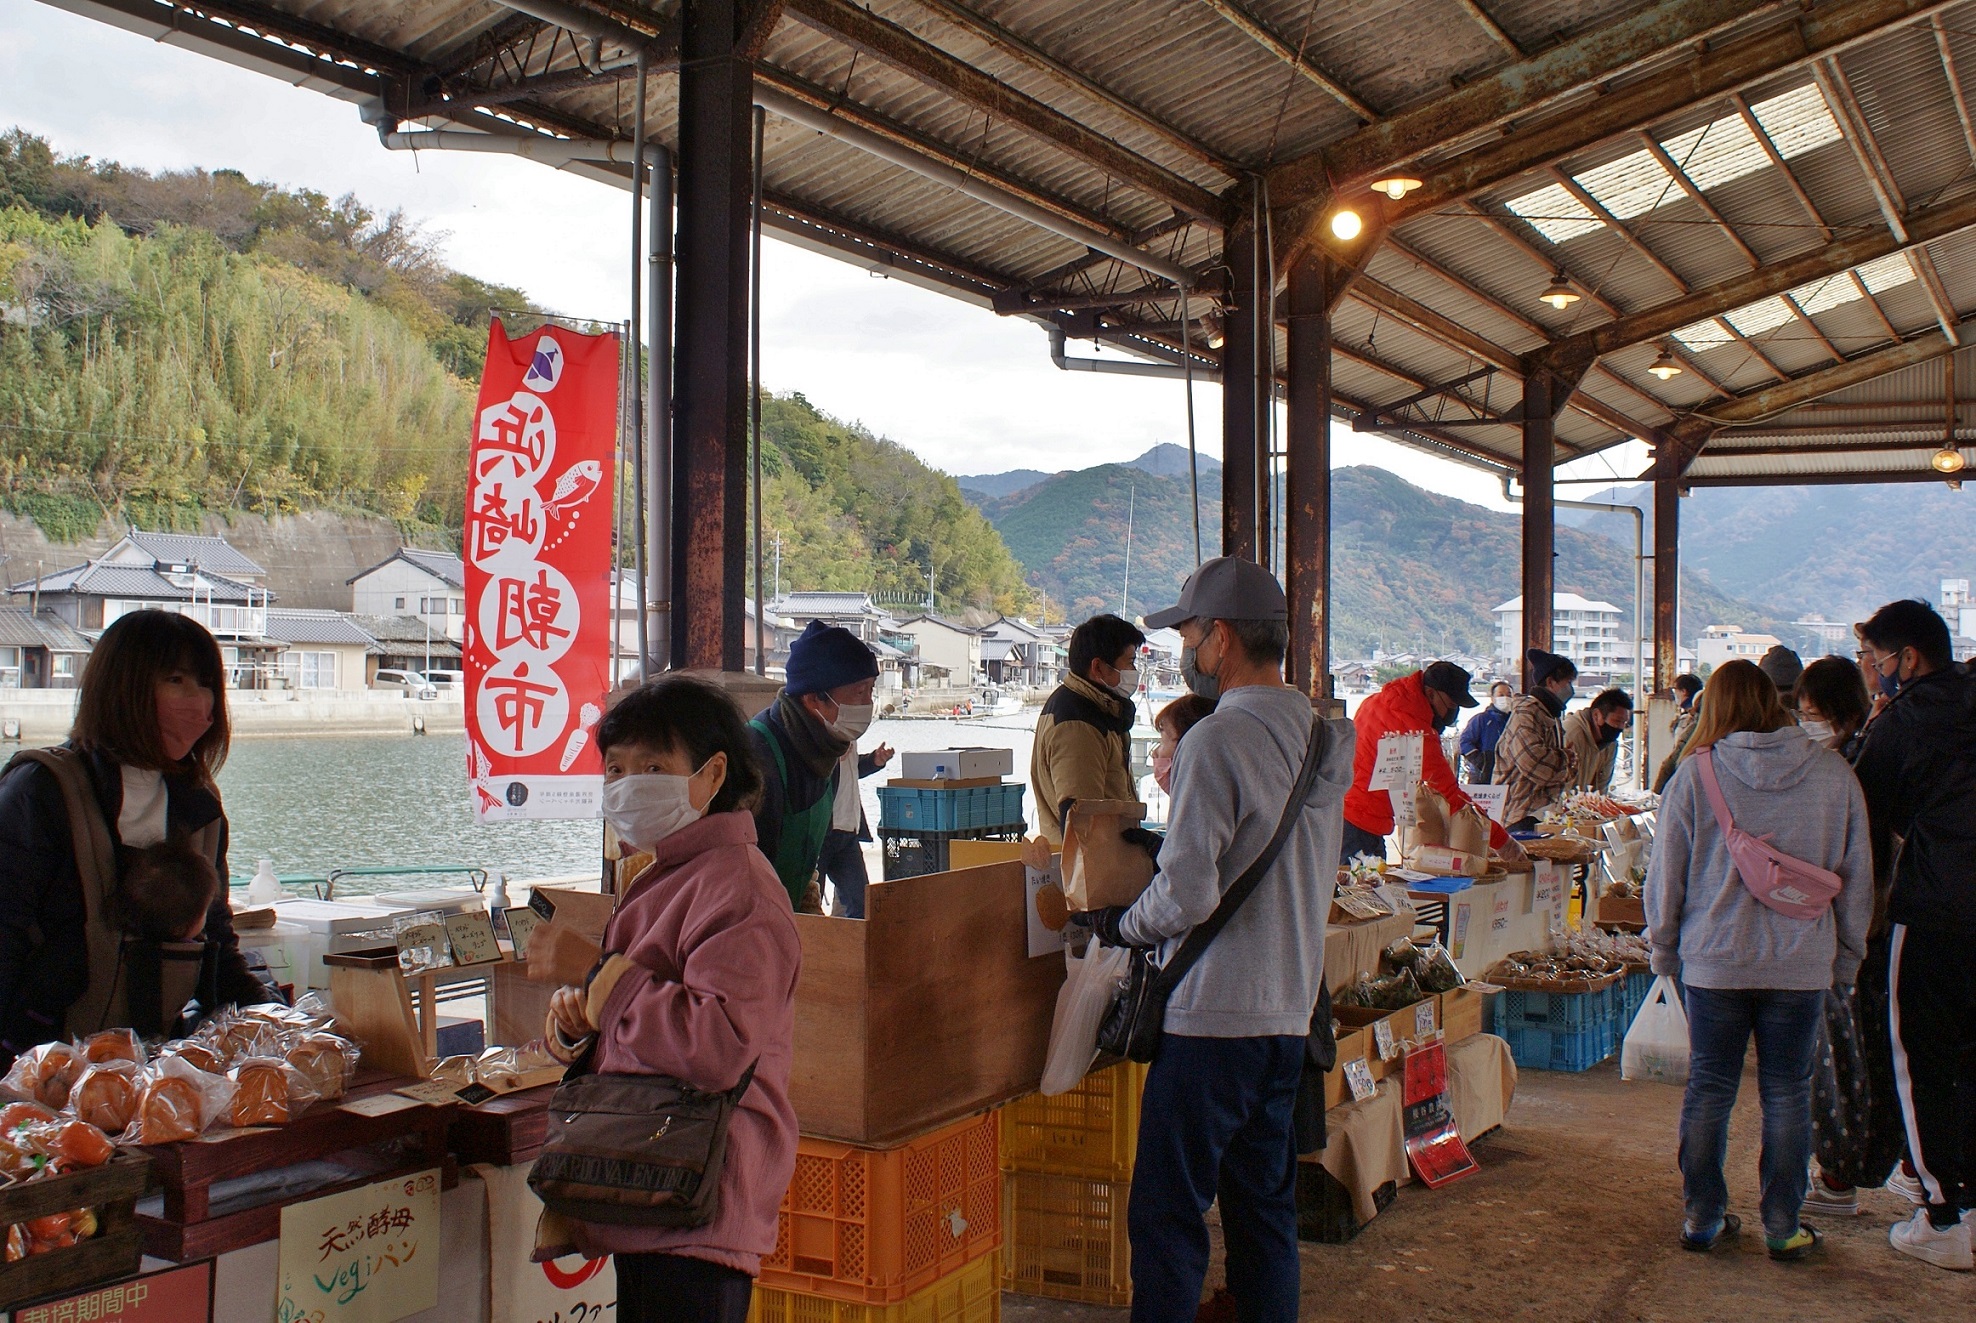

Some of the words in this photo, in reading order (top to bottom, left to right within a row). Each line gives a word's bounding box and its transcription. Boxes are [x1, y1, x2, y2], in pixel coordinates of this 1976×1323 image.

[1779, 885, 1811, 900] NIKE
[604, 1161, 692, 1192] VALENTINO
[318, 1204, 415, 1264] 天然酵母
